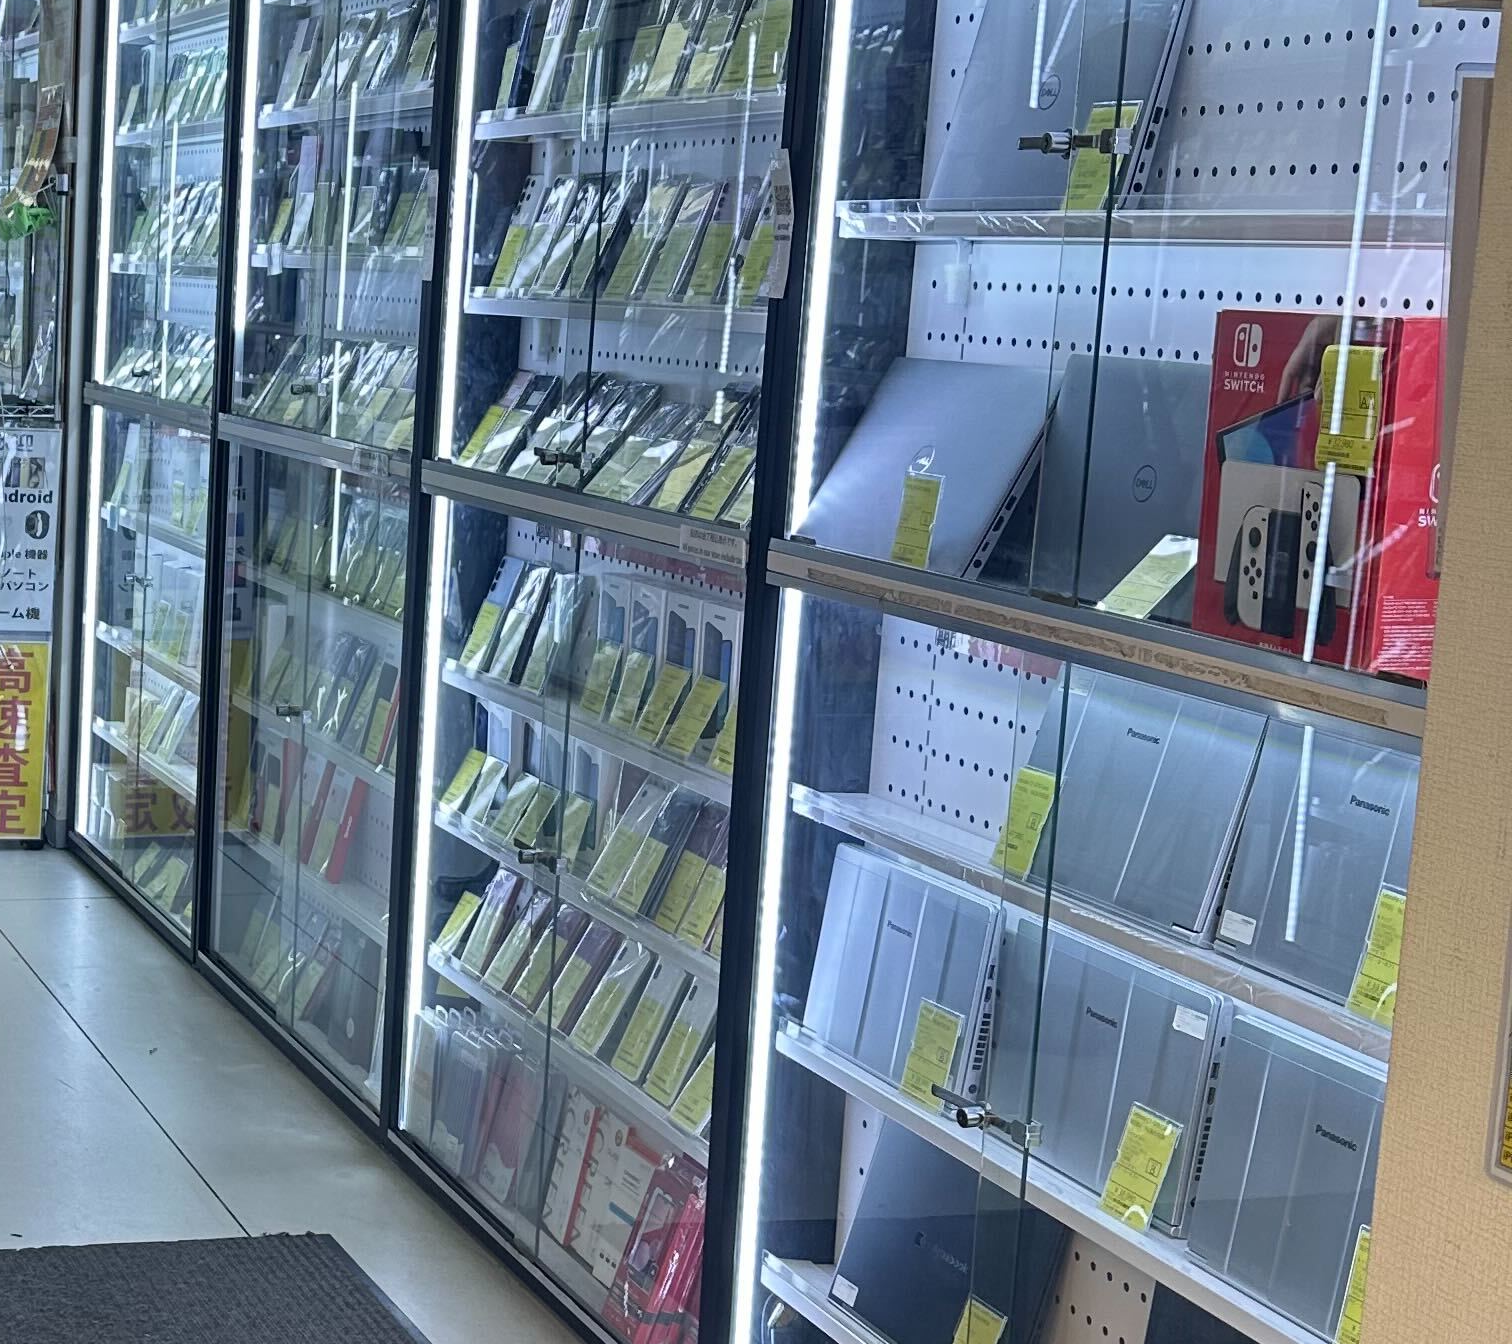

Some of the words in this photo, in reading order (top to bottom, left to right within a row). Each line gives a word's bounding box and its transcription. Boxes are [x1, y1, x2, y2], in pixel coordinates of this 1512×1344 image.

[1224, 370, 1265, 381] NINTENDO
[1223, 378, 1265, 393] SWITCH
[25, 548, 48, 560] 機器
[2, 567, 37, 580] ノート
[0, 582, 50, 592] パソコン
[1126, 727, 1162, 746] Panasonic
[1349, 794, 1391, 817] Panasonic
[887, 920, 914, 939] Panasonic
[1086, 1006, 1119, 1029] Panasonic
[1314, 1123, 1359, 1153] Panasonic
